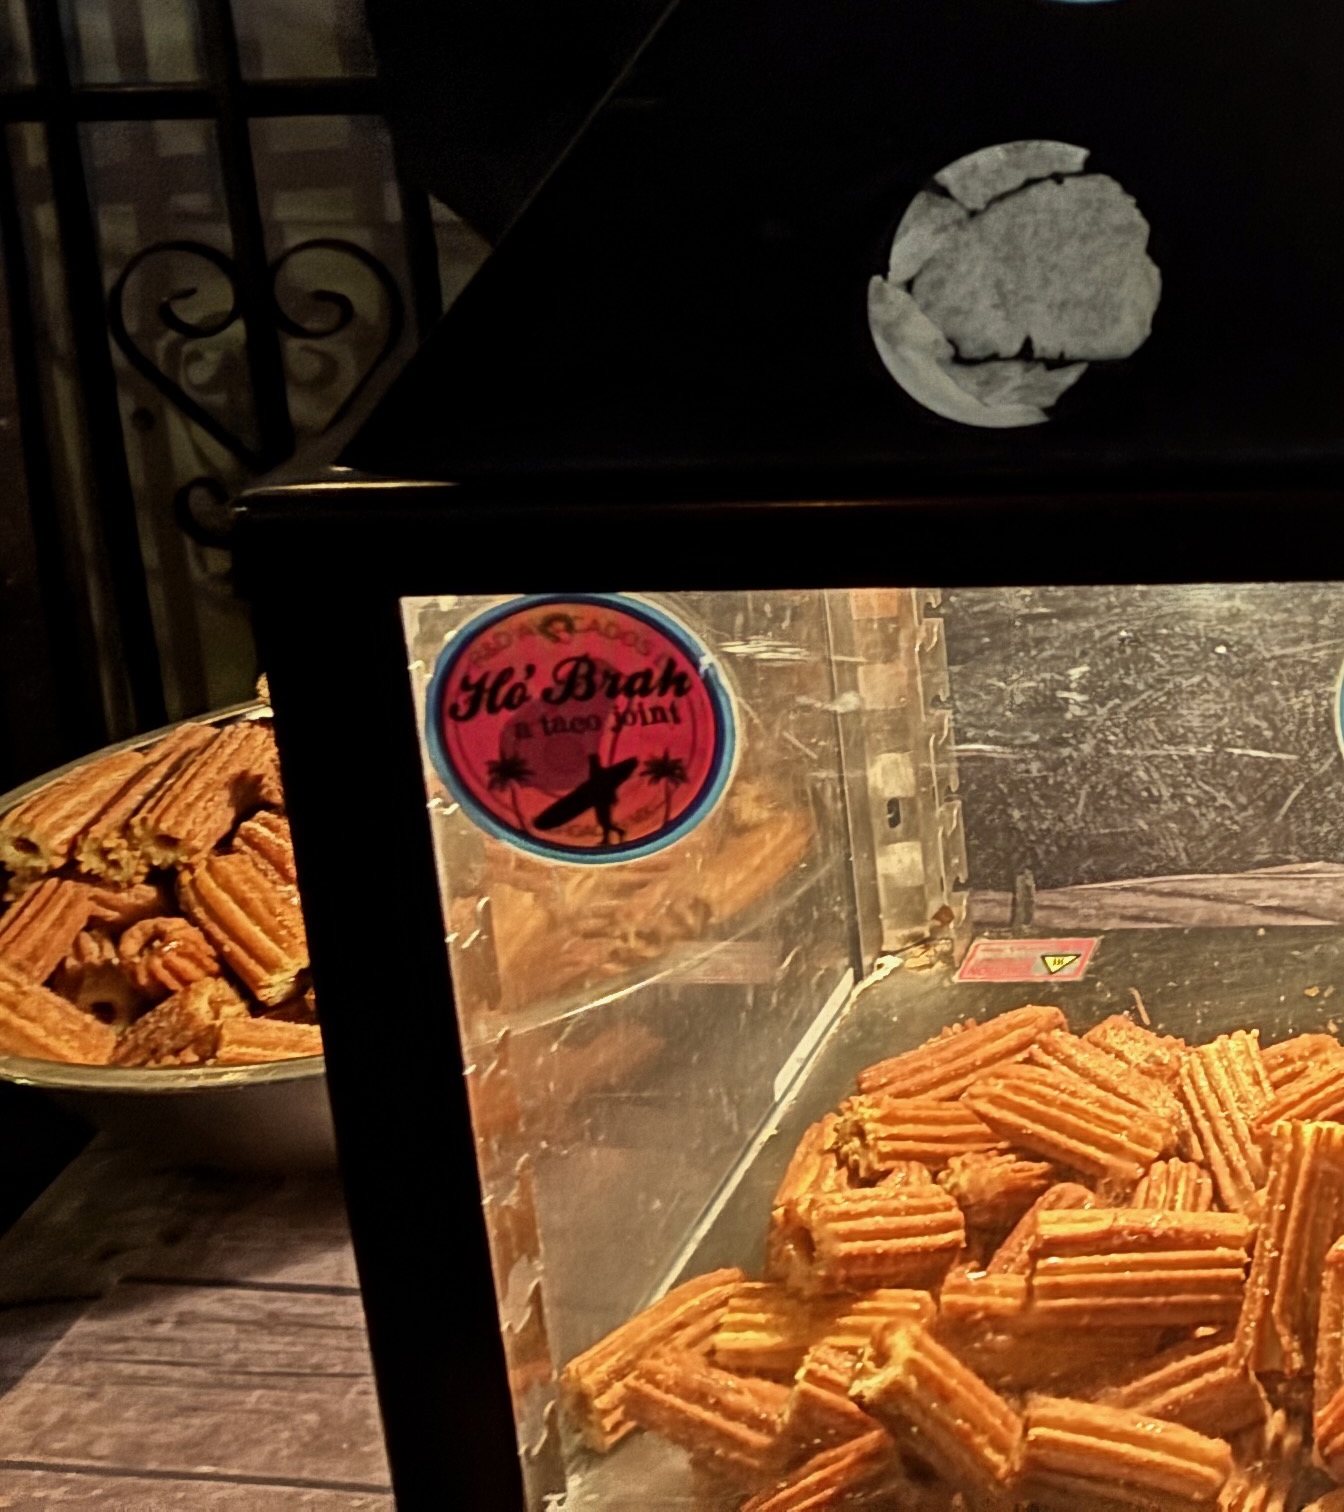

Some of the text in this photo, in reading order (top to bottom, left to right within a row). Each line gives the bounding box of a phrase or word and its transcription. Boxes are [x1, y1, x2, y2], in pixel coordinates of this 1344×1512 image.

[516, 702, 681, 738] a taco joint
